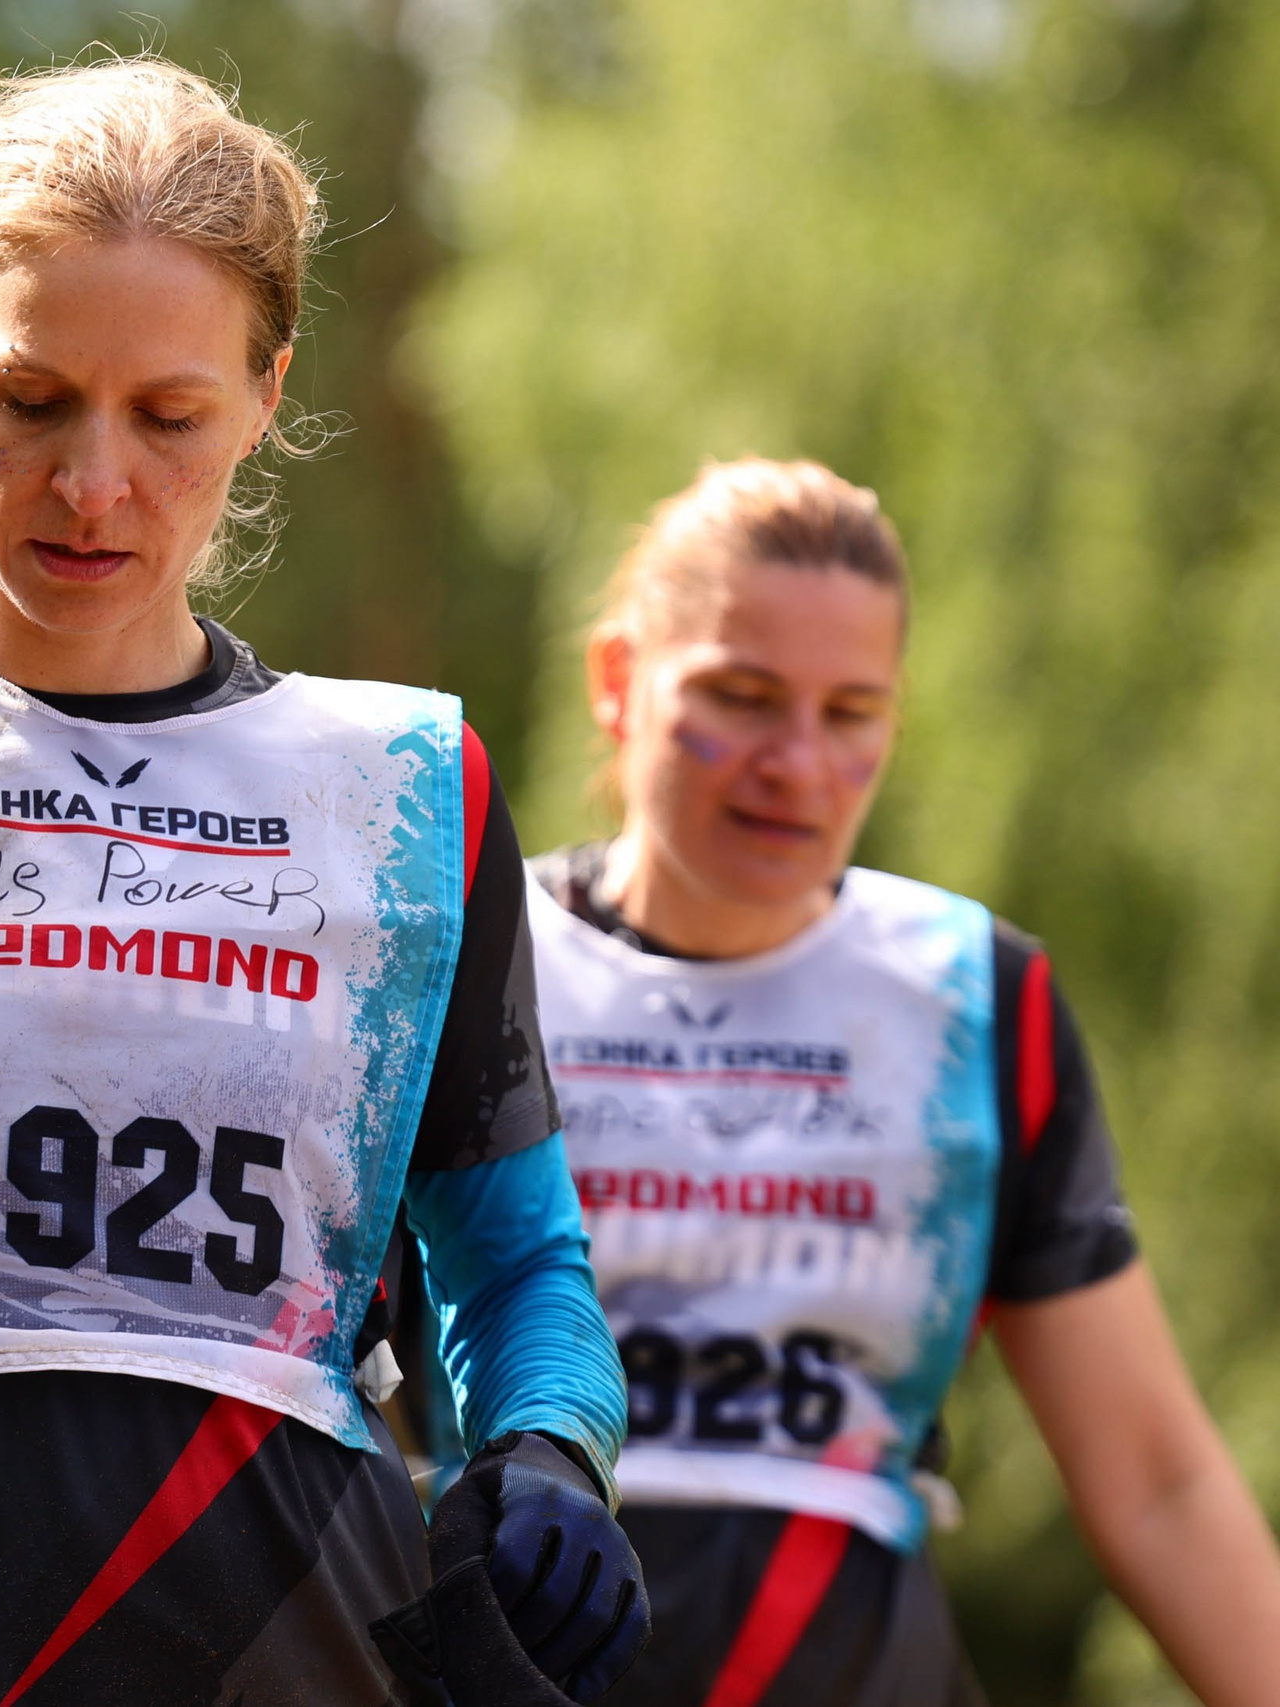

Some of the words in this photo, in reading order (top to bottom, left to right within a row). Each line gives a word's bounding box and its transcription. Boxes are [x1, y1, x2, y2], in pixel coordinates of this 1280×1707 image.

[110, 801, 291, 845] ГЕРОЕВ
[554, 1036, 682, 1067] ГОНКА
[695, 1041, 849, 1073] ГЕРОЕВ
[576, 1169, 877, 1221] EDMOND
[620, 1326, 845, 1443] 926
